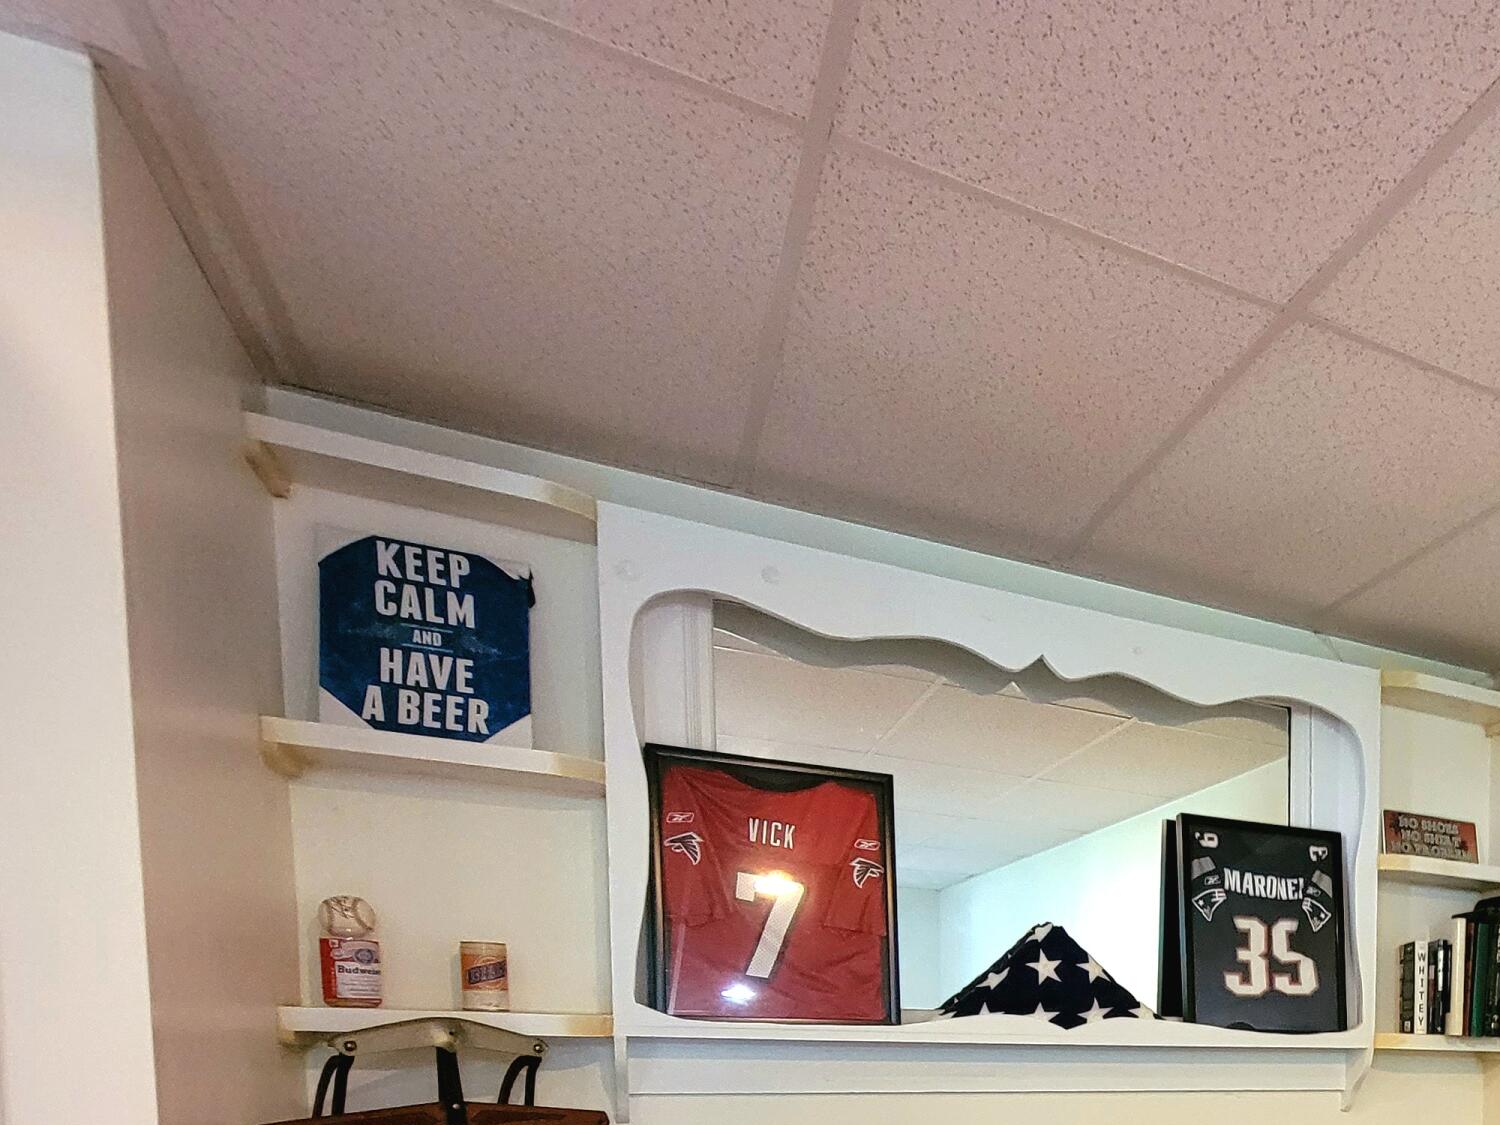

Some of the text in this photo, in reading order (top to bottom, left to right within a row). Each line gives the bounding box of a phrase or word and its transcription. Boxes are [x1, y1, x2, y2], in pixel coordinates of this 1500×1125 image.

[375, 539, 470, 588] KEEP
[374, 579, 475, 629] CALM
[412, 629, 442, 647] AND
[380, 647, 474, 694] HAVE
[361, 684, 489, 735] A BEER
[748, 817, 796, 850] VICK
[1398, 815, 1418, 829] NO
[735, 871, 805, 979] 7
[1417, 952, 1426, 1026] WHITEY
